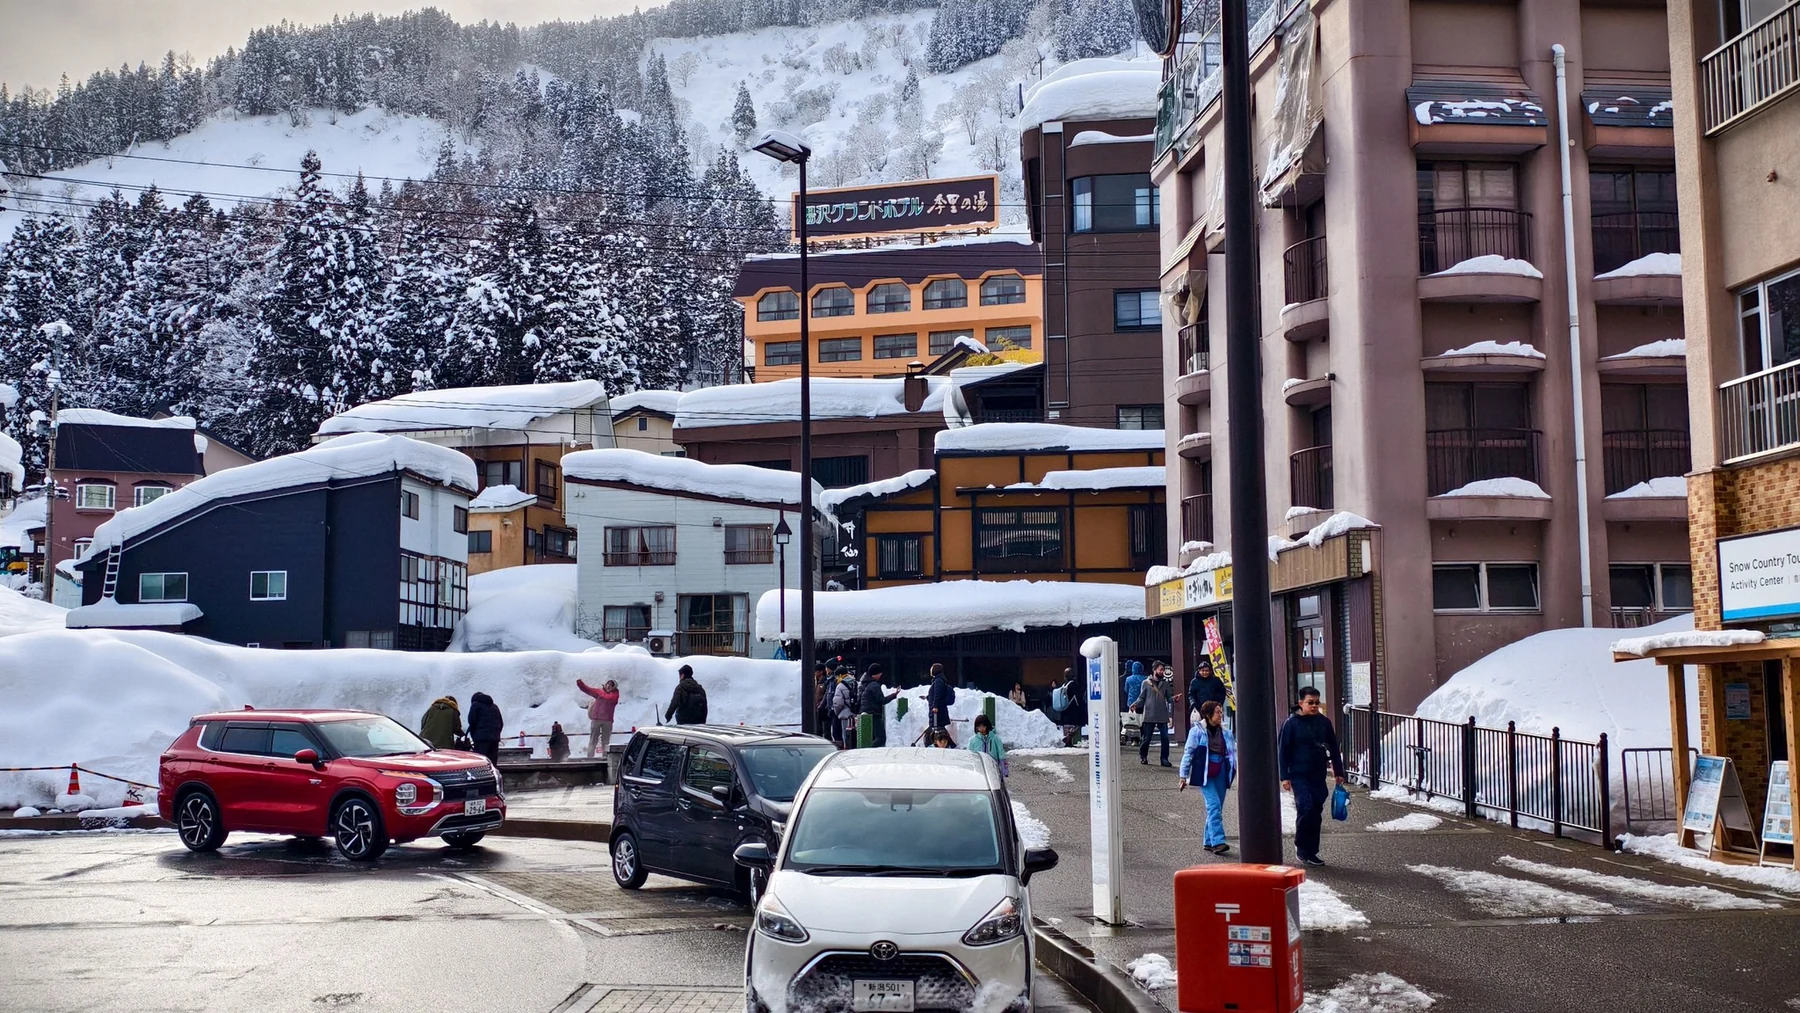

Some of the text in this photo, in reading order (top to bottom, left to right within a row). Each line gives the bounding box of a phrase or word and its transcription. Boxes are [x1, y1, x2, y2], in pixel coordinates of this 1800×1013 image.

[1729, 562, 1750, 573] Snow
[1752, 557, 1785, 570] Country
[1731, 579, 1757, 590] Activity
[1760, 576, 1784, 586] Center
